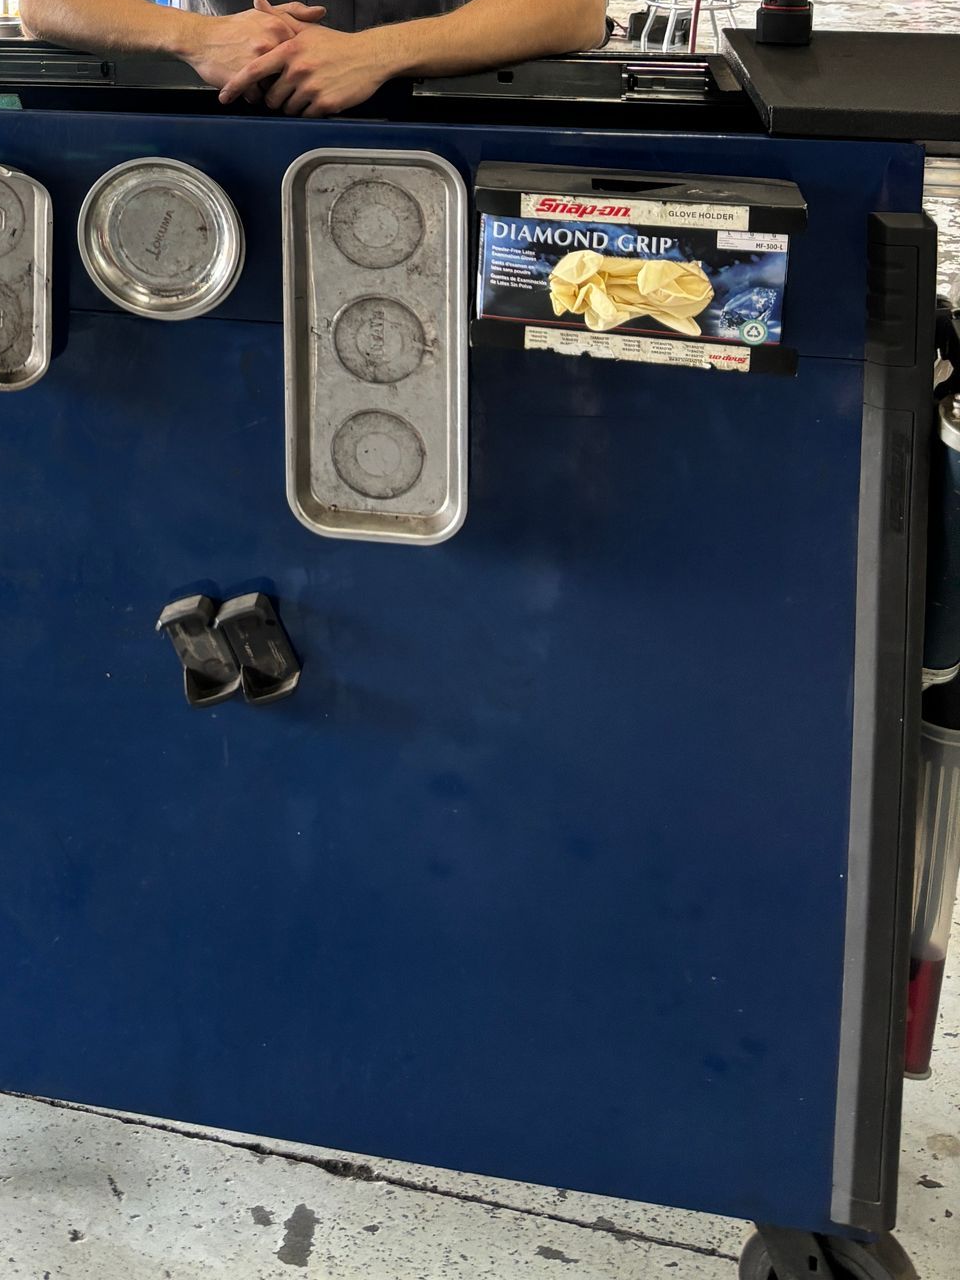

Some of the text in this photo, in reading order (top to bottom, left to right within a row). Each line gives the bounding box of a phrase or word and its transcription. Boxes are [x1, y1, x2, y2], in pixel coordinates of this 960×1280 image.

[535, 197, 734, 221] Snap-on GLOVE HOLDER
[492, 221, 672, 254] DIAMOND GRIP
